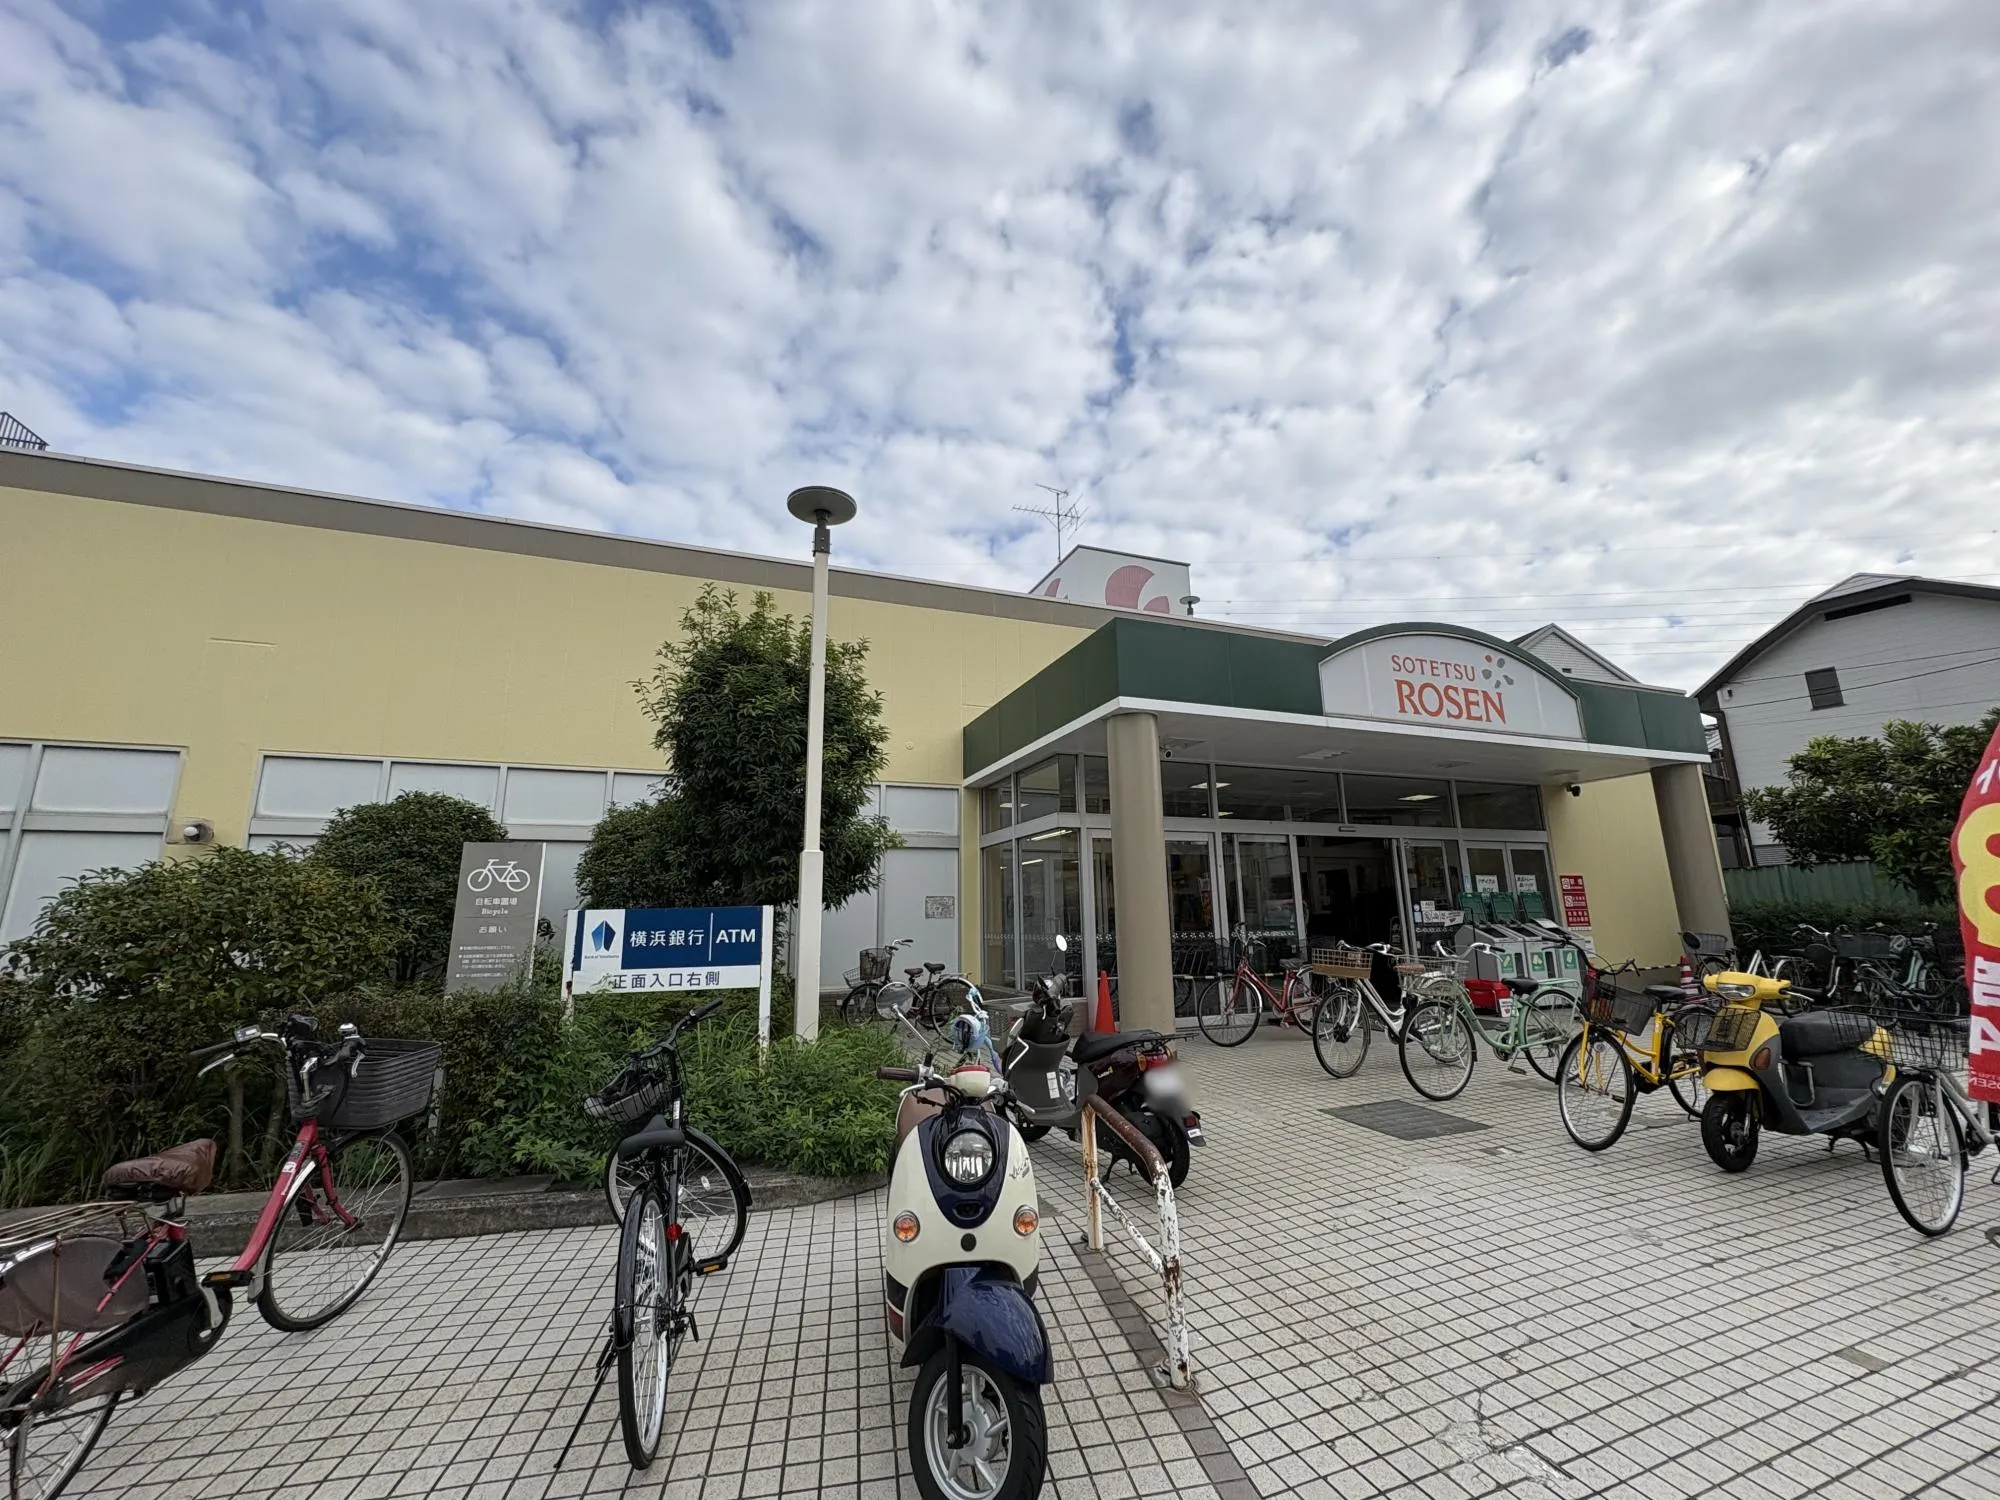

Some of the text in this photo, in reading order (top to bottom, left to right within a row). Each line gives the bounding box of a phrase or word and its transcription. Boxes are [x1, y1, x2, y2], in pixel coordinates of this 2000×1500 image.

[1391, 655, 1476, 682] SOTETSU
[1395, 679, 1506, 724] ROSEN
[481, 907, 509, 916] Bicycle
[629, 928, 756, 948] 横浜銀行 ATM
[611, 970, 720, 990] 正面入口右側
